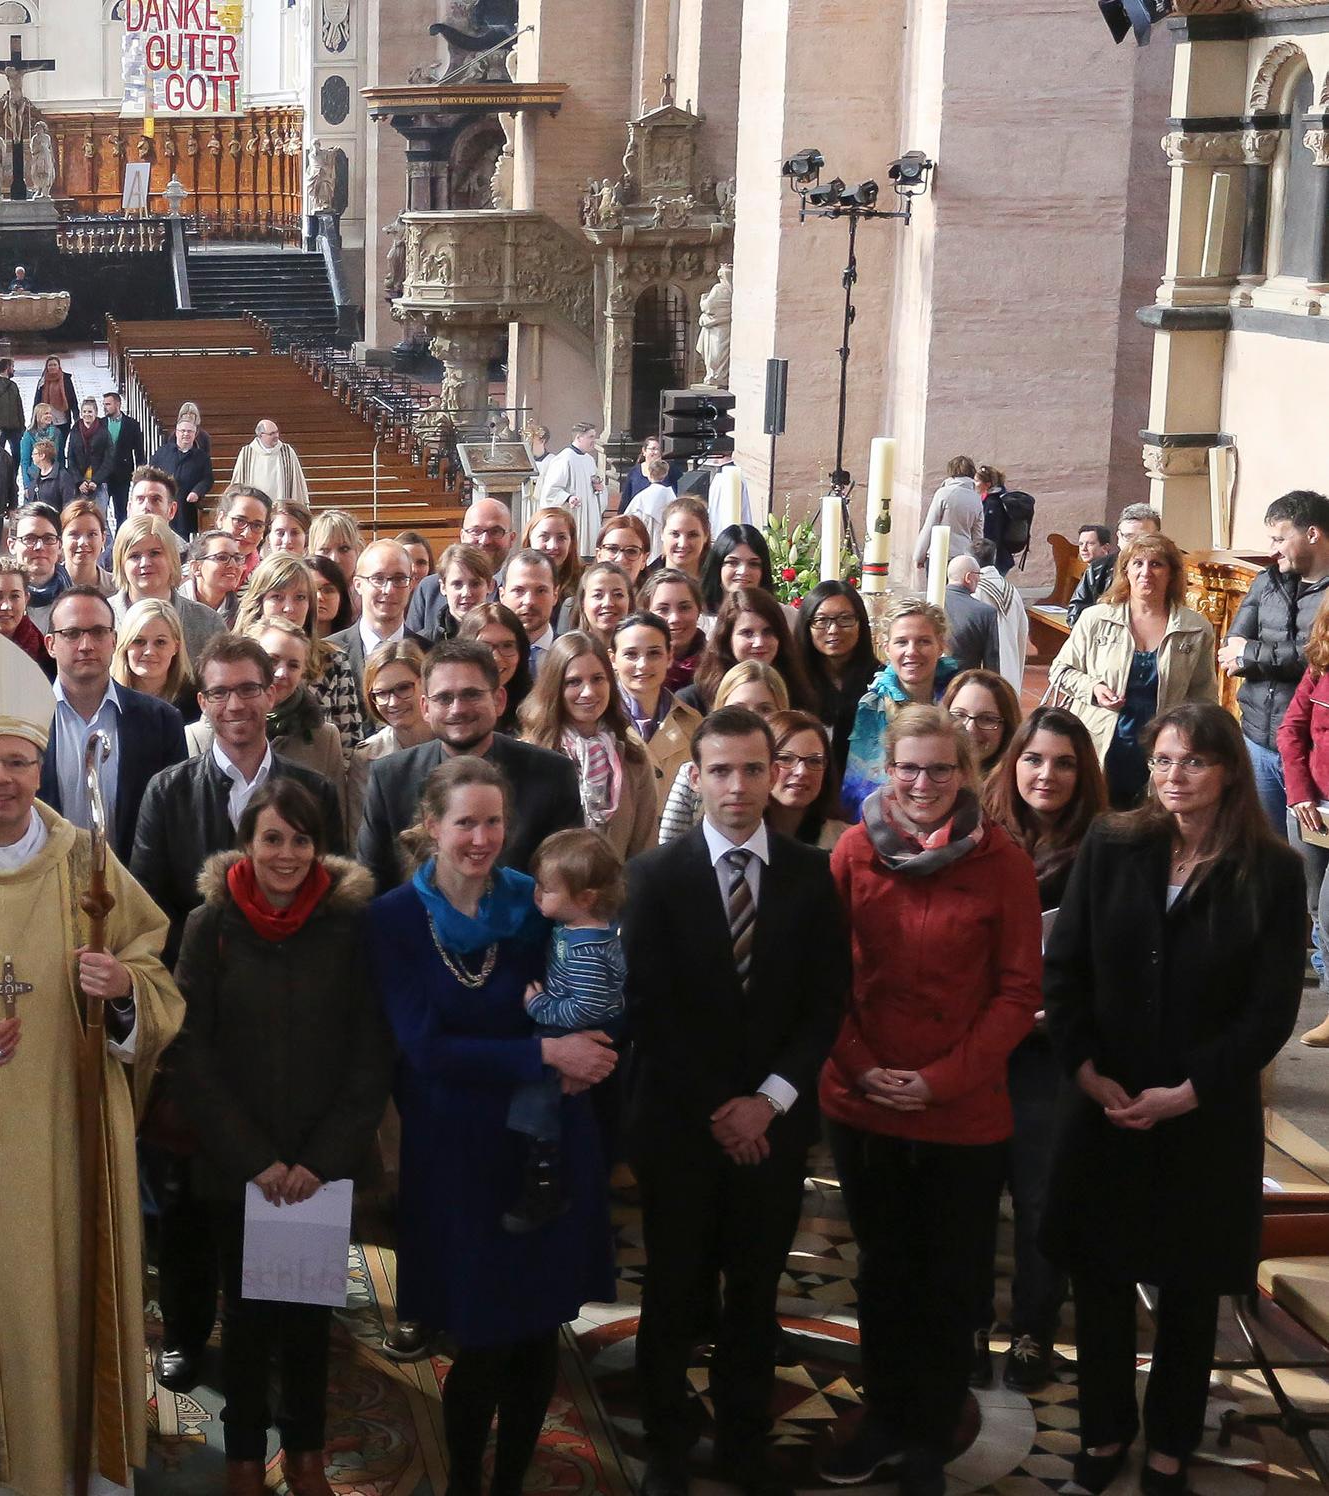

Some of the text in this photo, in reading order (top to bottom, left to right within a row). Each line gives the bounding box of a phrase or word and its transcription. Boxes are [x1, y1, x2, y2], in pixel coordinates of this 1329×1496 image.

[126, 0, 221, 32] DANKE
[145, 33, 239, 73] GUTER
[165, 73, 240, 113] GOTT
